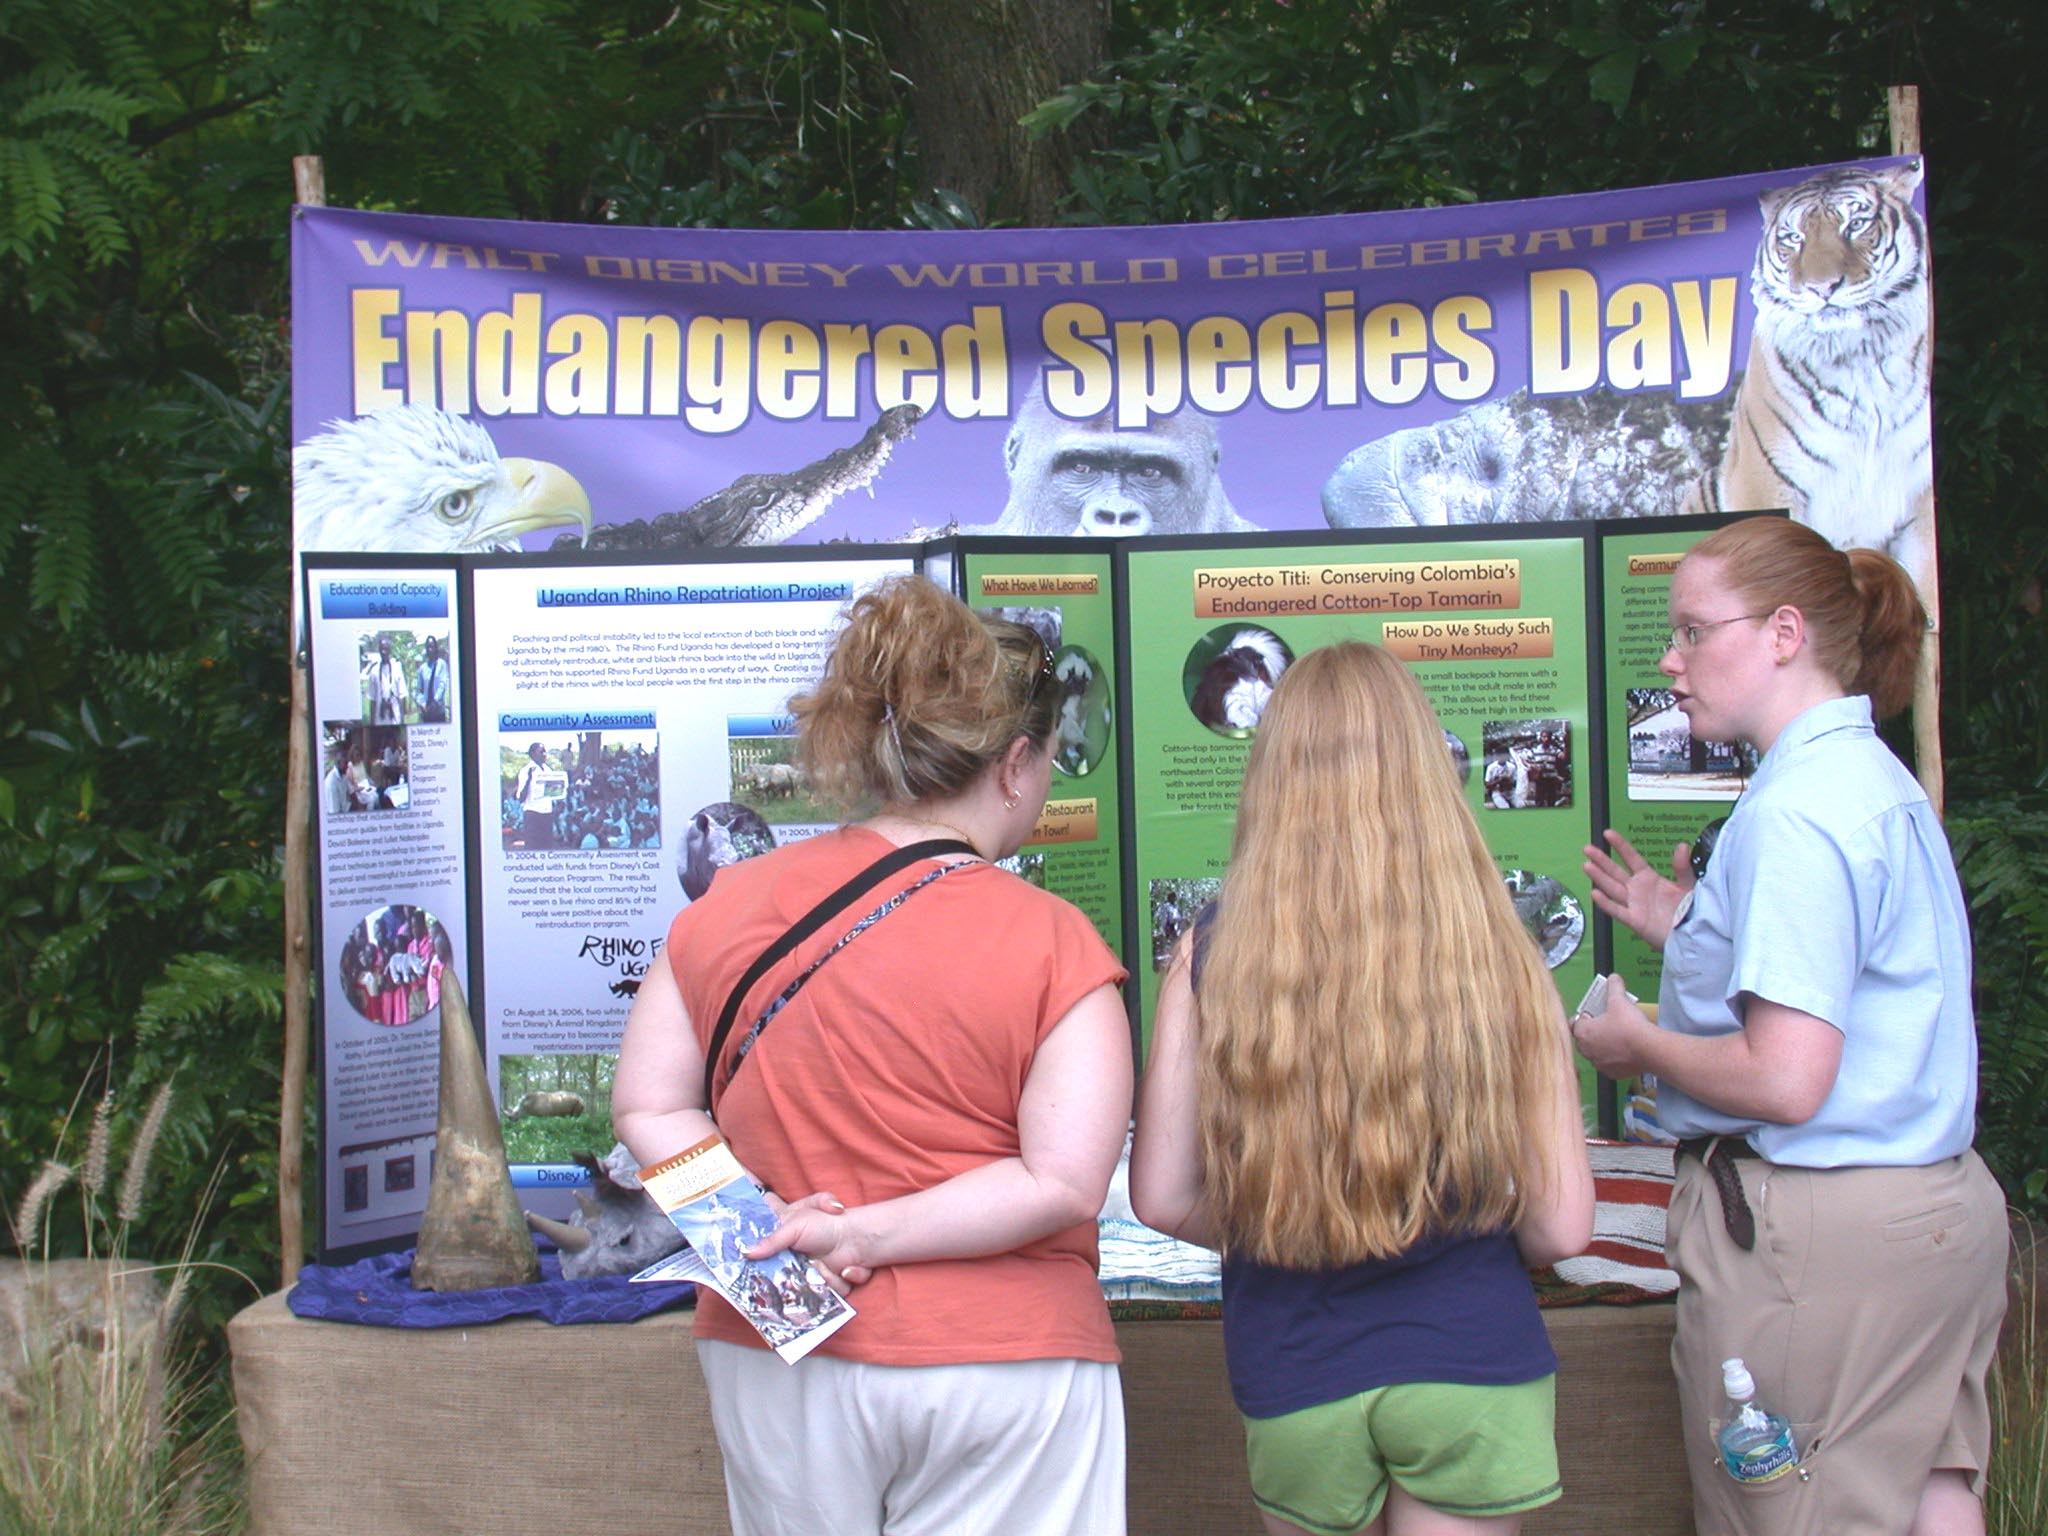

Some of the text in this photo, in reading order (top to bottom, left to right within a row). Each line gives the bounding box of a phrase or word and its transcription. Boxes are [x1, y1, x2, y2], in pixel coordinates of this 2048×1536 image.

[352, 208, 1728, 288] WALT DISNEY WORLD CELEBRATES
[350, 266, 1738, 434] Endangered Species Day
[1199, 563, 1515, 591] Proyecto Titi: Conserving Colombia's
[330, 583, 441, 597] Education and Capacity
[983, 579, 1097, 591] What Have We Learned?
[542, 584, 846, 606] Ugandan Rhino Repatriation Project
[368, 603, 406, 615] Building
[1213, 590, 1501, 615] Endangered Cotton-Top Tamarin
[1387, 622, 1550, 639] How Do We Study Such
[513, 635, 550, 643] Poaching
[570, 634, 600, 642] political
[508, 647, 539, 655] Uganda
[542, 646, 551, 654] by
[731, 642, 772, 650] developed
[1419, 643, 1518, 659] Tiny Monkeys?
[512, 670, 547, 678] Kingdom
[656, 667, 687, 675] Uganda
[708, 666, 735, 674] variety
[774, 664, 808, 672] Creating
[1455, 671, 1496, 679] backpack
[516, 681, 538, 690] plight
[726, 677, 742, 685] step
[1443, 695, 1458, 703] This
[1489, 707, 1505, 715] high
[502, 713, 653, 728] Community Assessment
[1163, 745, 1207, 753] Cotton-top
[1046, 804, 1093, 816] Restaurant
[1044, 824, 1070, 837] Town!
[548, 852, 593, 860] Community
[514, 875, 564, 883] Conservation
[522, 910, 548, 918] people
[572, 909, 602, 917] positive
[578, 935, 645, 967] RHINO
[518, 1008, 545, 1017] August
[502, 1020, 520, 1028] from
[587, 1020, 622, 1028] Kingdom
[538, 1169, 579, 1183] Disney
[1740, 1448, 1791, 1474] Zephyrhills
